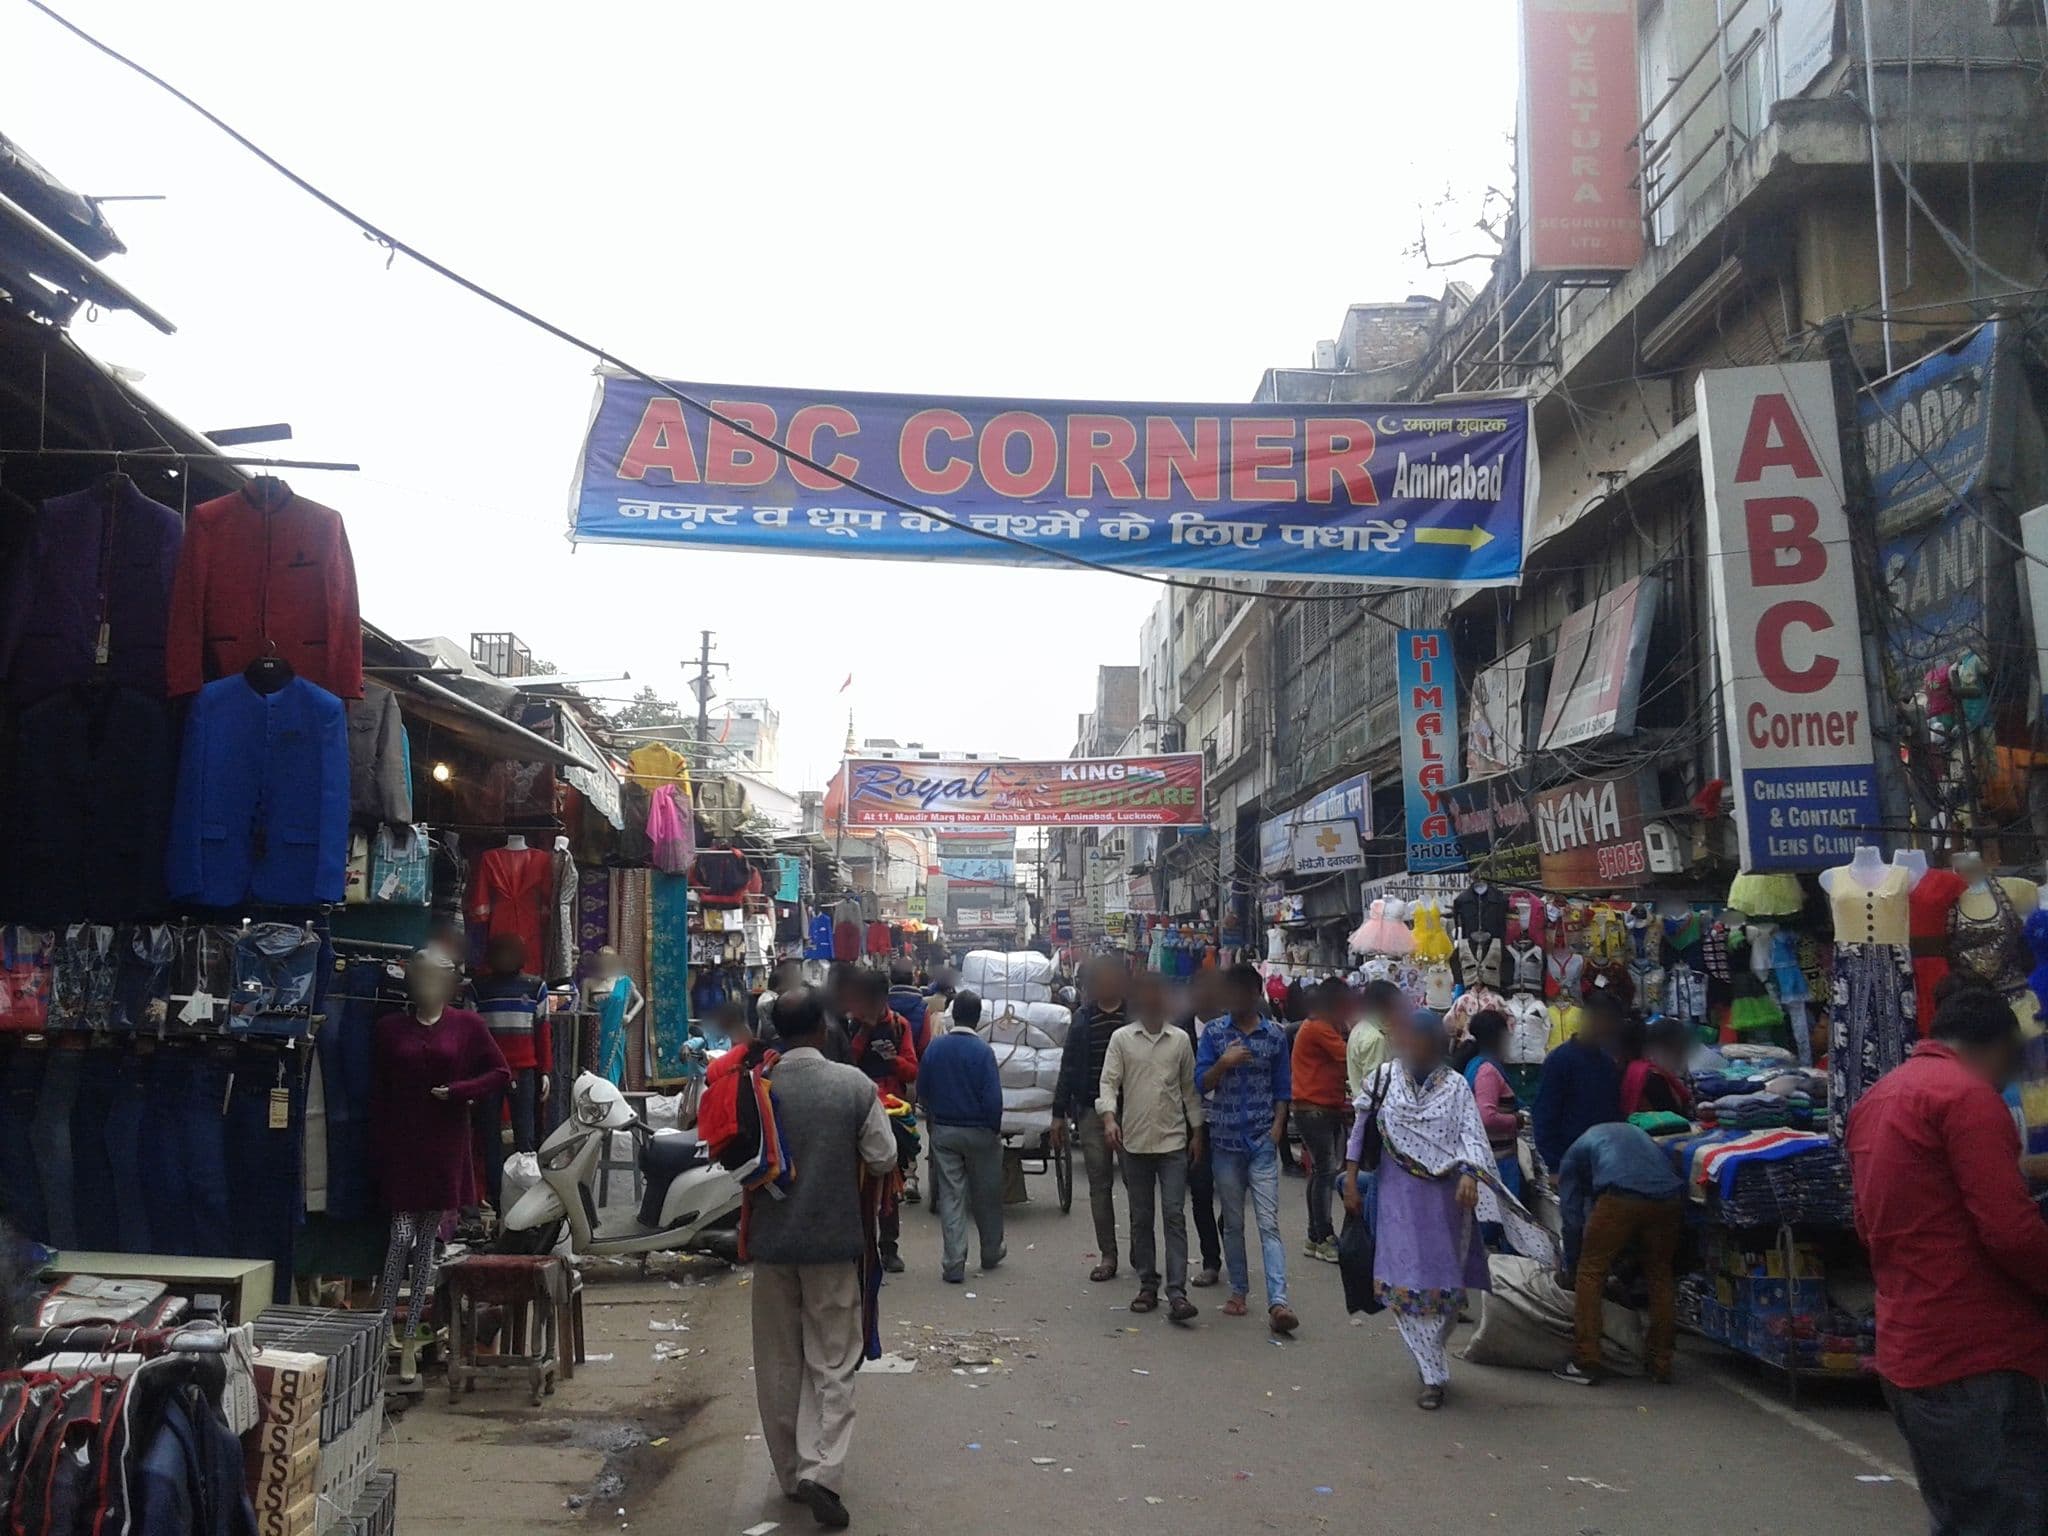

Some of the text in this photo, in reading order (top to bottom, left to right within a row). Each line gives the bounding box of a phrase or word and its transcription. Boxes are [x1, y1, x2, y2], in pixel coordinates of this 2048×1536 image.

[1568, 24, 1601, 203] VENTURA
[1402, 418, 1508, 437] रमज़ान मुबारक
[617, 397, 1379, 506] ABC CORNER
[1392, 451, 1504, 502] Aminabad
[617, 497, 743, 530] नज़र
[752, 505, 793, 529] व
[806, 505, 886, 538] धूप
[899, 500, 952, 534] के
[1099, 512, 1154, 542] के
[1169, 511, 1267, 550] लिए
[1279, 518, 1408, 552] पधारें
[1733, 393, 1840, 694] ABC
[1411, 635, 1449, 841] HIMALAYA
[1747, 702, 1859, 750] Corner
[852, 765, 992, 808] Royal
[1060, 763, 1125, 782] KING
[1754, 779, 1869, 800] CHASHMEWALE
[863, 812, 877, 821] At
[895, 812, 928, 821] Mandir
[931, 812, 955, 823] Marg
[957, 812, 981, 821] Near
[1536, 781, 1621, 855] NAMA
[1770, 806, 1857, 828] & CONTACT
[1411, 843, 1463, 861] SHOES
[1597, 840, 1643, 881] SHOES
[1768, 836, 1809, 857] LENS
[266, 1003, 308, 1015] LAPAZ
